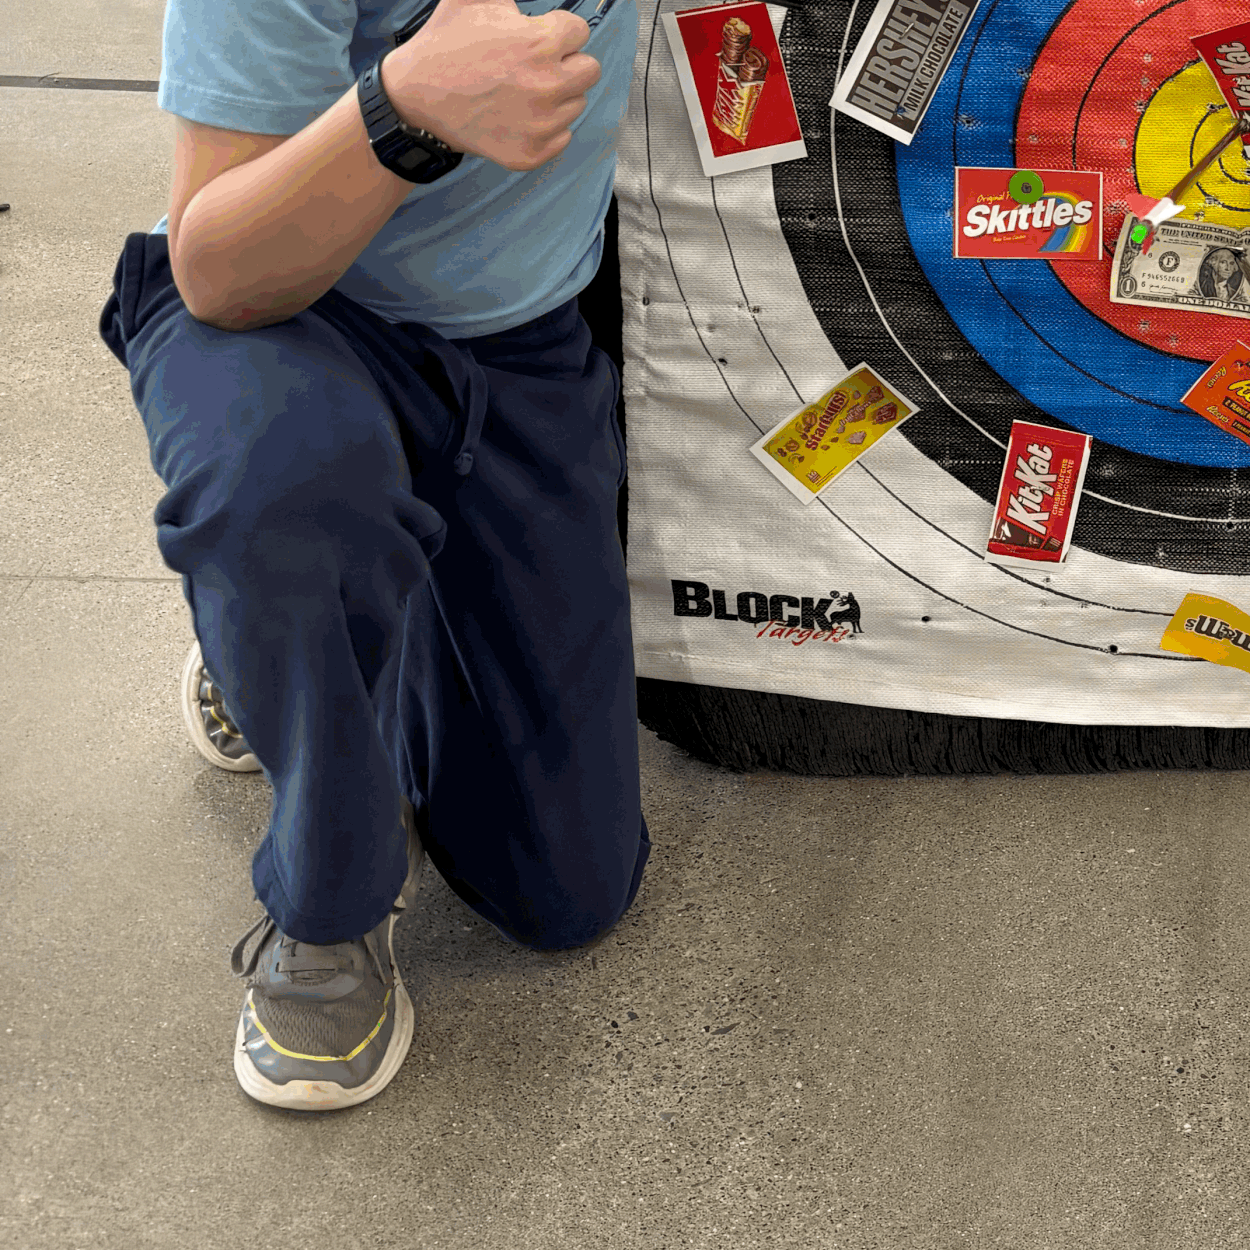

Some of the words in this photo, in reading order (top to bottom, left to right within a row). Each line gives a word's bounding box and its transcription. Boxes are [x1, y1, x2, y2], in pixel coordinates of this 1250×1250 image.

[903, 78, 929, 112] MILK
[920, 7, 963, 80] CHOCOLATE
[963, 198, 1093, 237] Skittles
[805, 390, 849, 450] Starburst
[671, 579, 835, 632] BLOCK
[756, 619, 849, 645] Targets
